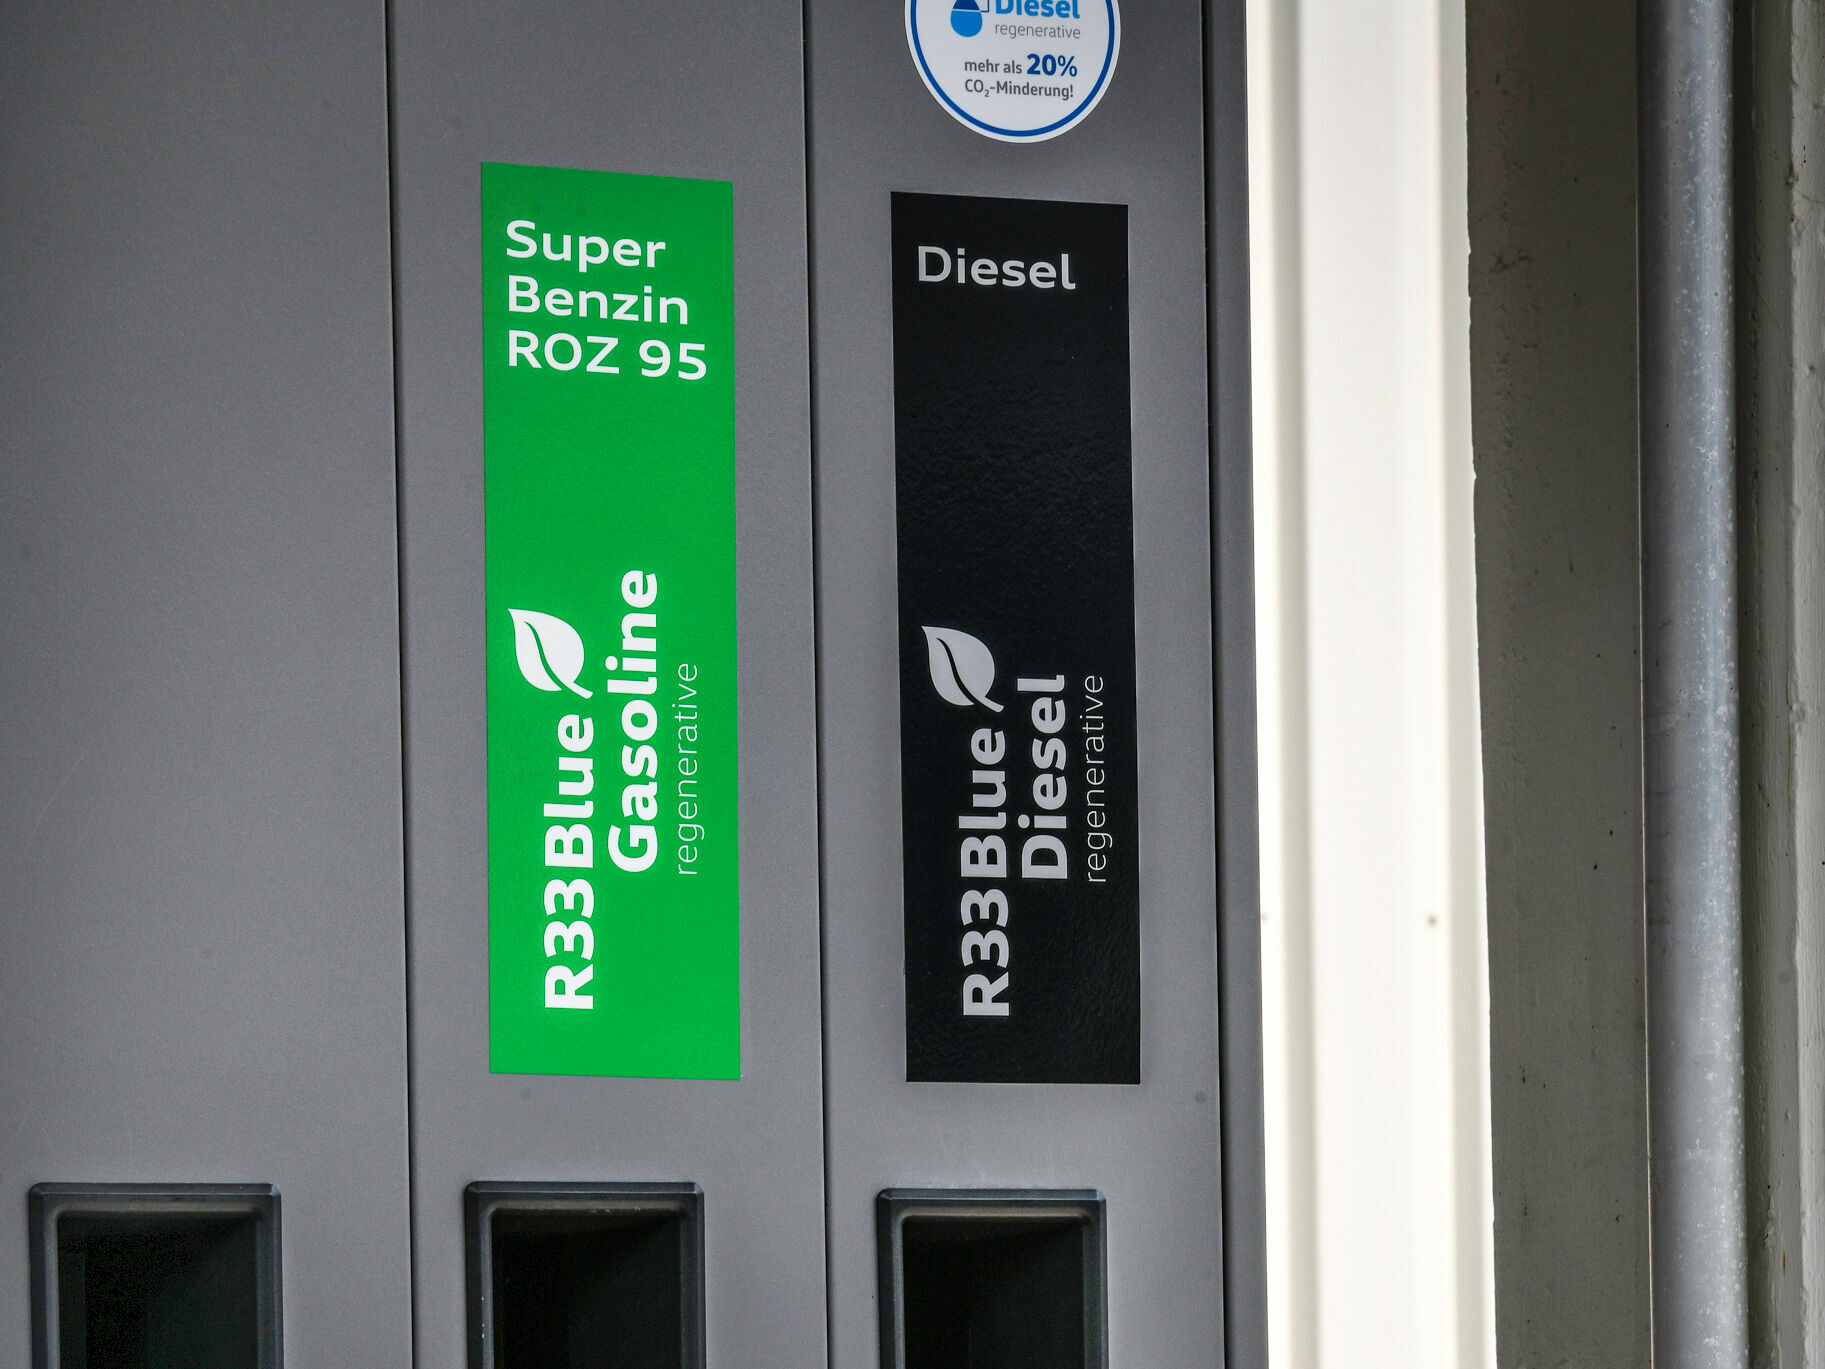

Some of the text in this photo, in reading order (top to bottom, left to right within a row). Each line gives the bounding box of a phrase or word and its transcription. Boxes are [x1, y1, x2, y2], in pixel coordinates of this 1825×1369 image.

[994, 24, 1081, 39] regenerative
[964, 53, 1078, 77] mehr als 20%
[507, 220, 665, 272] Super
[919, 246, 1075, 289] Diesel
[508, 274, 688, 325] Benzin
[509, 330, 706, 380] ROZ 95
[605, 571, 657, 872] Gasoline
[672, 664, 704, 874] regenerative
[1017, 675, 1067, 879] Diesel
[1080, 676, 1112, 881] regenerative
